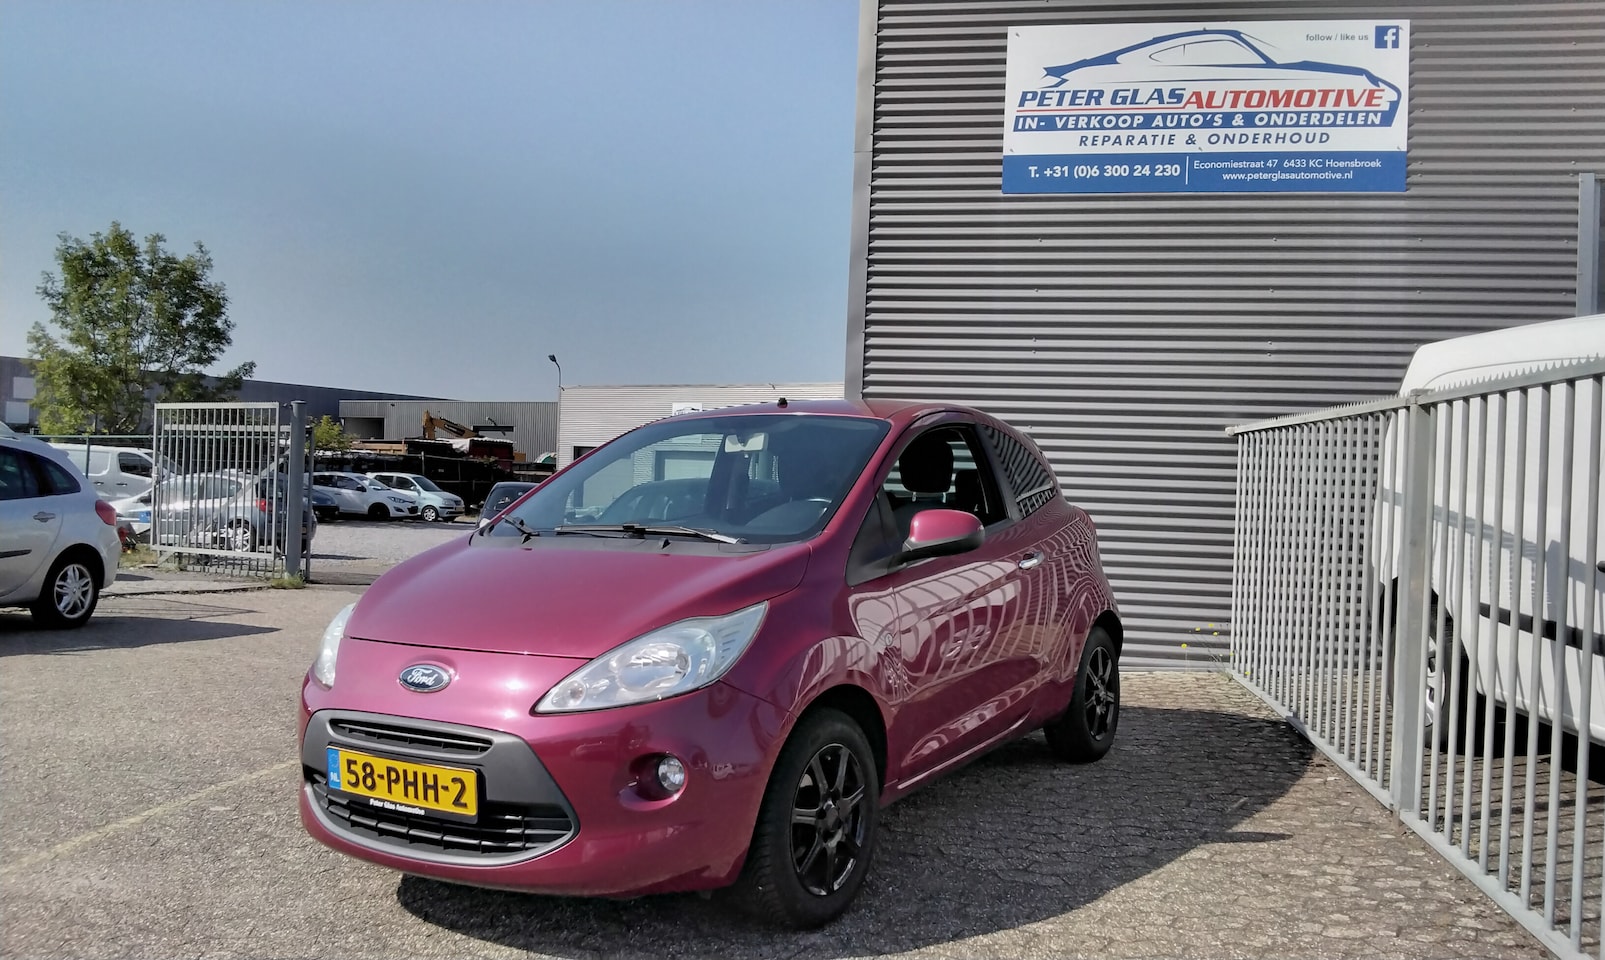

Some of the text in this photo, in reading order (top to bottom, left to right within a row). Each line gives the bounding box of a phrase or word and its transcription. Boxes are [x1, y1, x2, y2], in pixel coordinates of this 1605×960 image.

[1306, 33, 1332, 41] follow
[1340, 33, 1355, 41] like
[1017, 88, 1385, 109] PETER GLAS AUTOMOTIVE
[1017, 112, 1382, 130] IN- VERKOOP AUTO'S & ONDERDELEN
[1079, 132, 1330, 147] REPARATIE & ONDERHOUD
[1193, 158, 1382, 170] Economiestraat 47 6433 KC Hoensbroek
[1028, 164, 1181, 180] T. +31 (0)6 300 24 230
[1222, 170, 1353, 182] www.peterglasautomotive.nl
[407, 668, 438, 686] Ford
[330, 771, 340, 783] NL
[346, 758, 468, 809] 58-PHH-2
